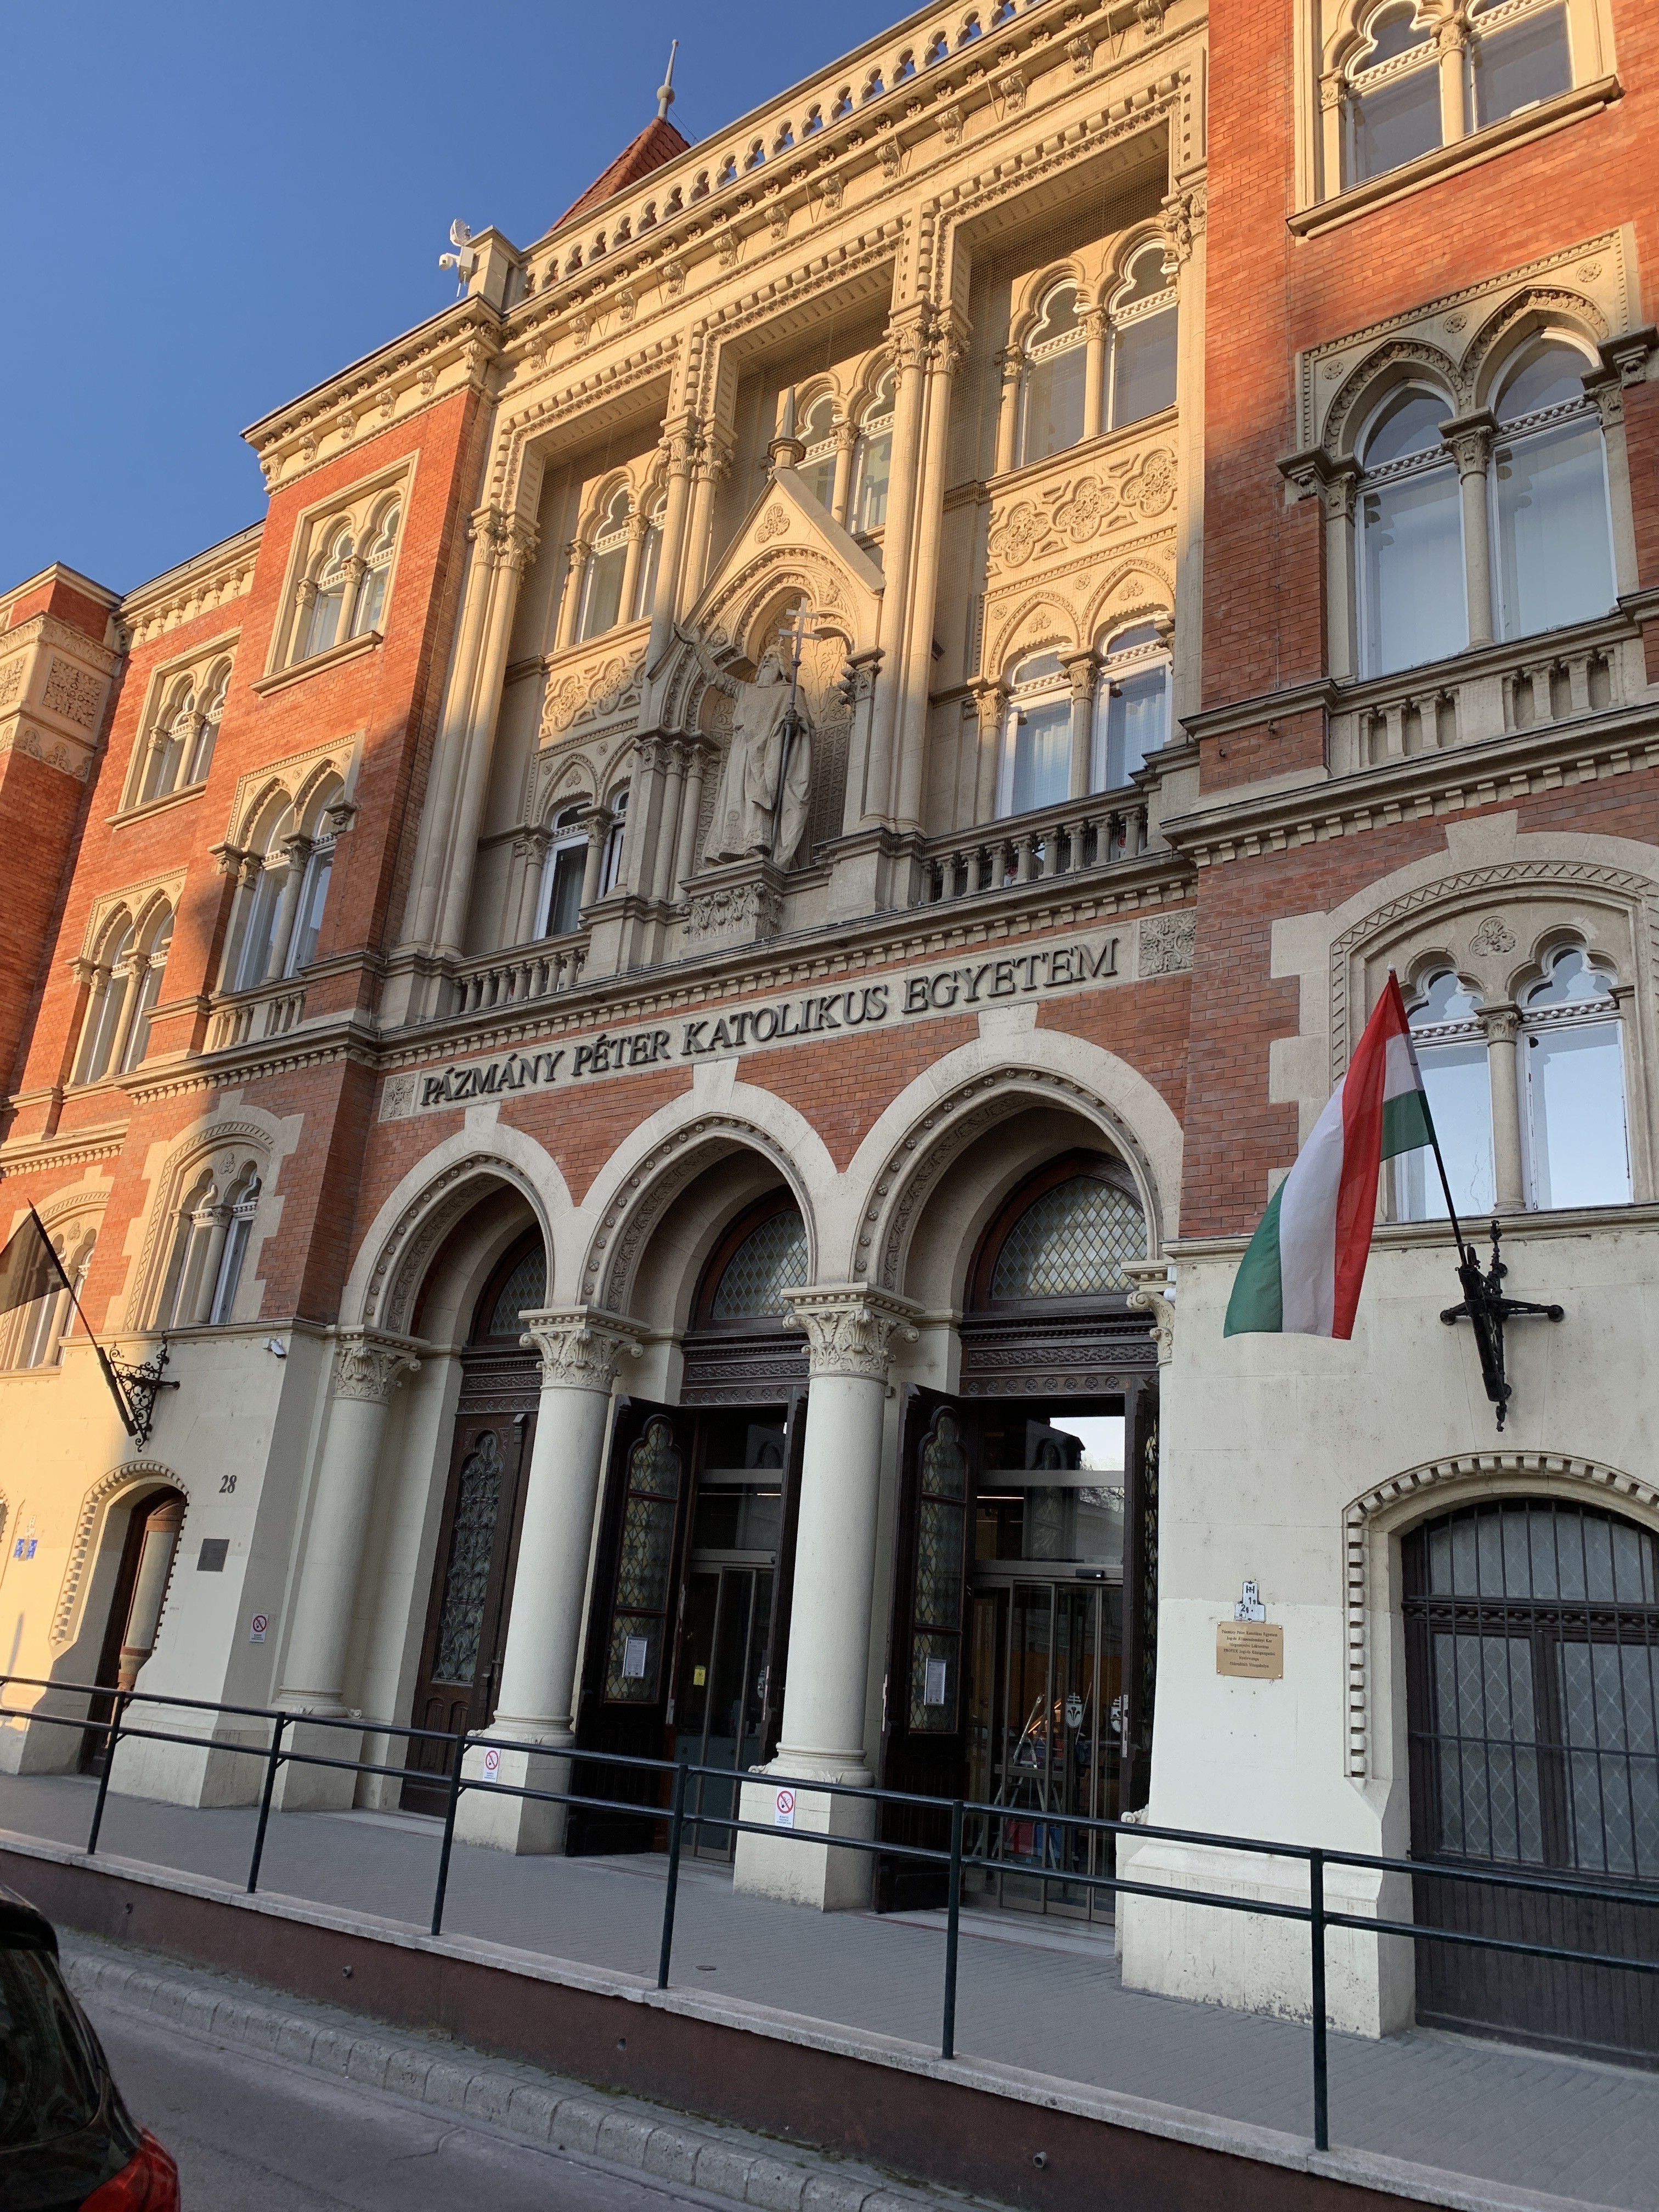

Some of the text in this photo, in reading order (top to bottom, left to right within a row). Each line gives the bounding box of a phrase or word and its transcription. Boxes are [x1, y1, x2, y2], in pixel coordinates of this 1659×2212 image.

[420, 938, 1120, 1107] PÁZMÁNY PÉTER KATOLIKUS EGYETEM
[219, 1475, 237, 1493] 28
